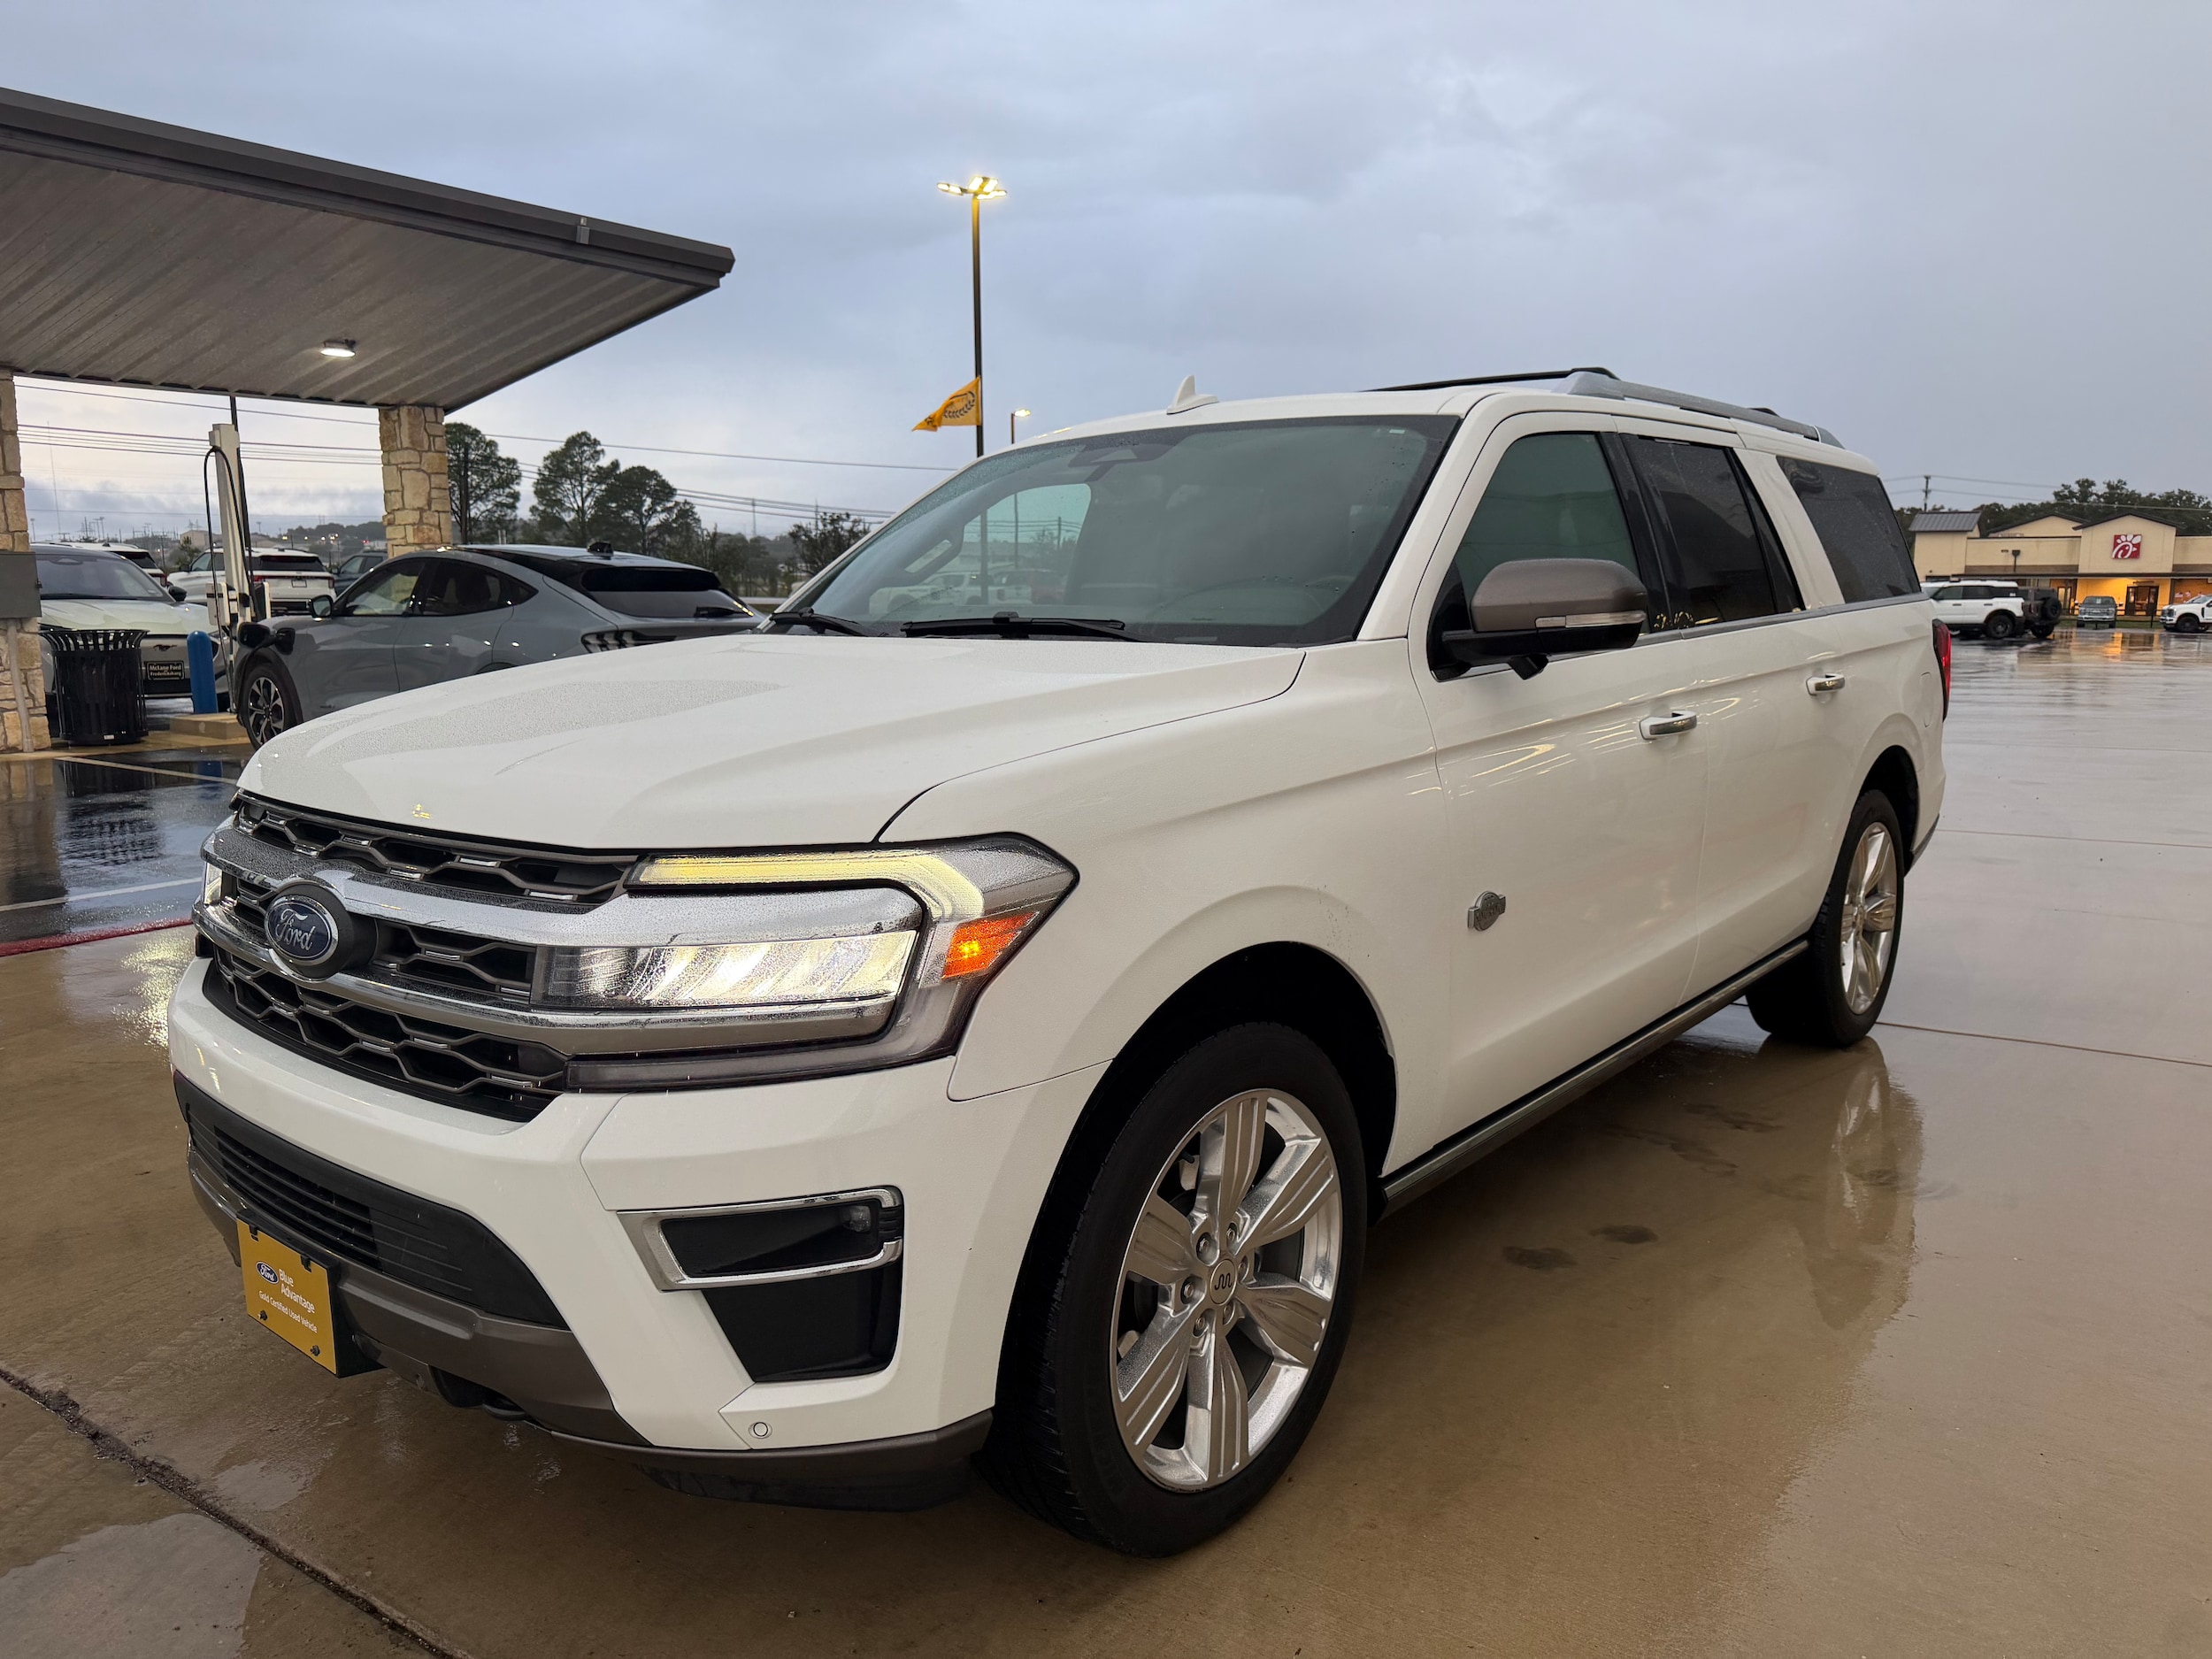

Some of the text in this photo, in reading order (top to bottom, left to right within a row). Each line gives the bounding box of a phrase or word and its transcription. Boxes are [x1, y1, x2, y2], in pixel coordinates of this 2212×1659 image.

[275, 908, 316, 950] Ford
[258, 1263, 275, 1282] Ford
[279, 1269, 294, 1286] Blue
[258, 1290, 318, 1333] Gold Certified Used Vehicle
[280, 1283, 315, 1314] Advantage
